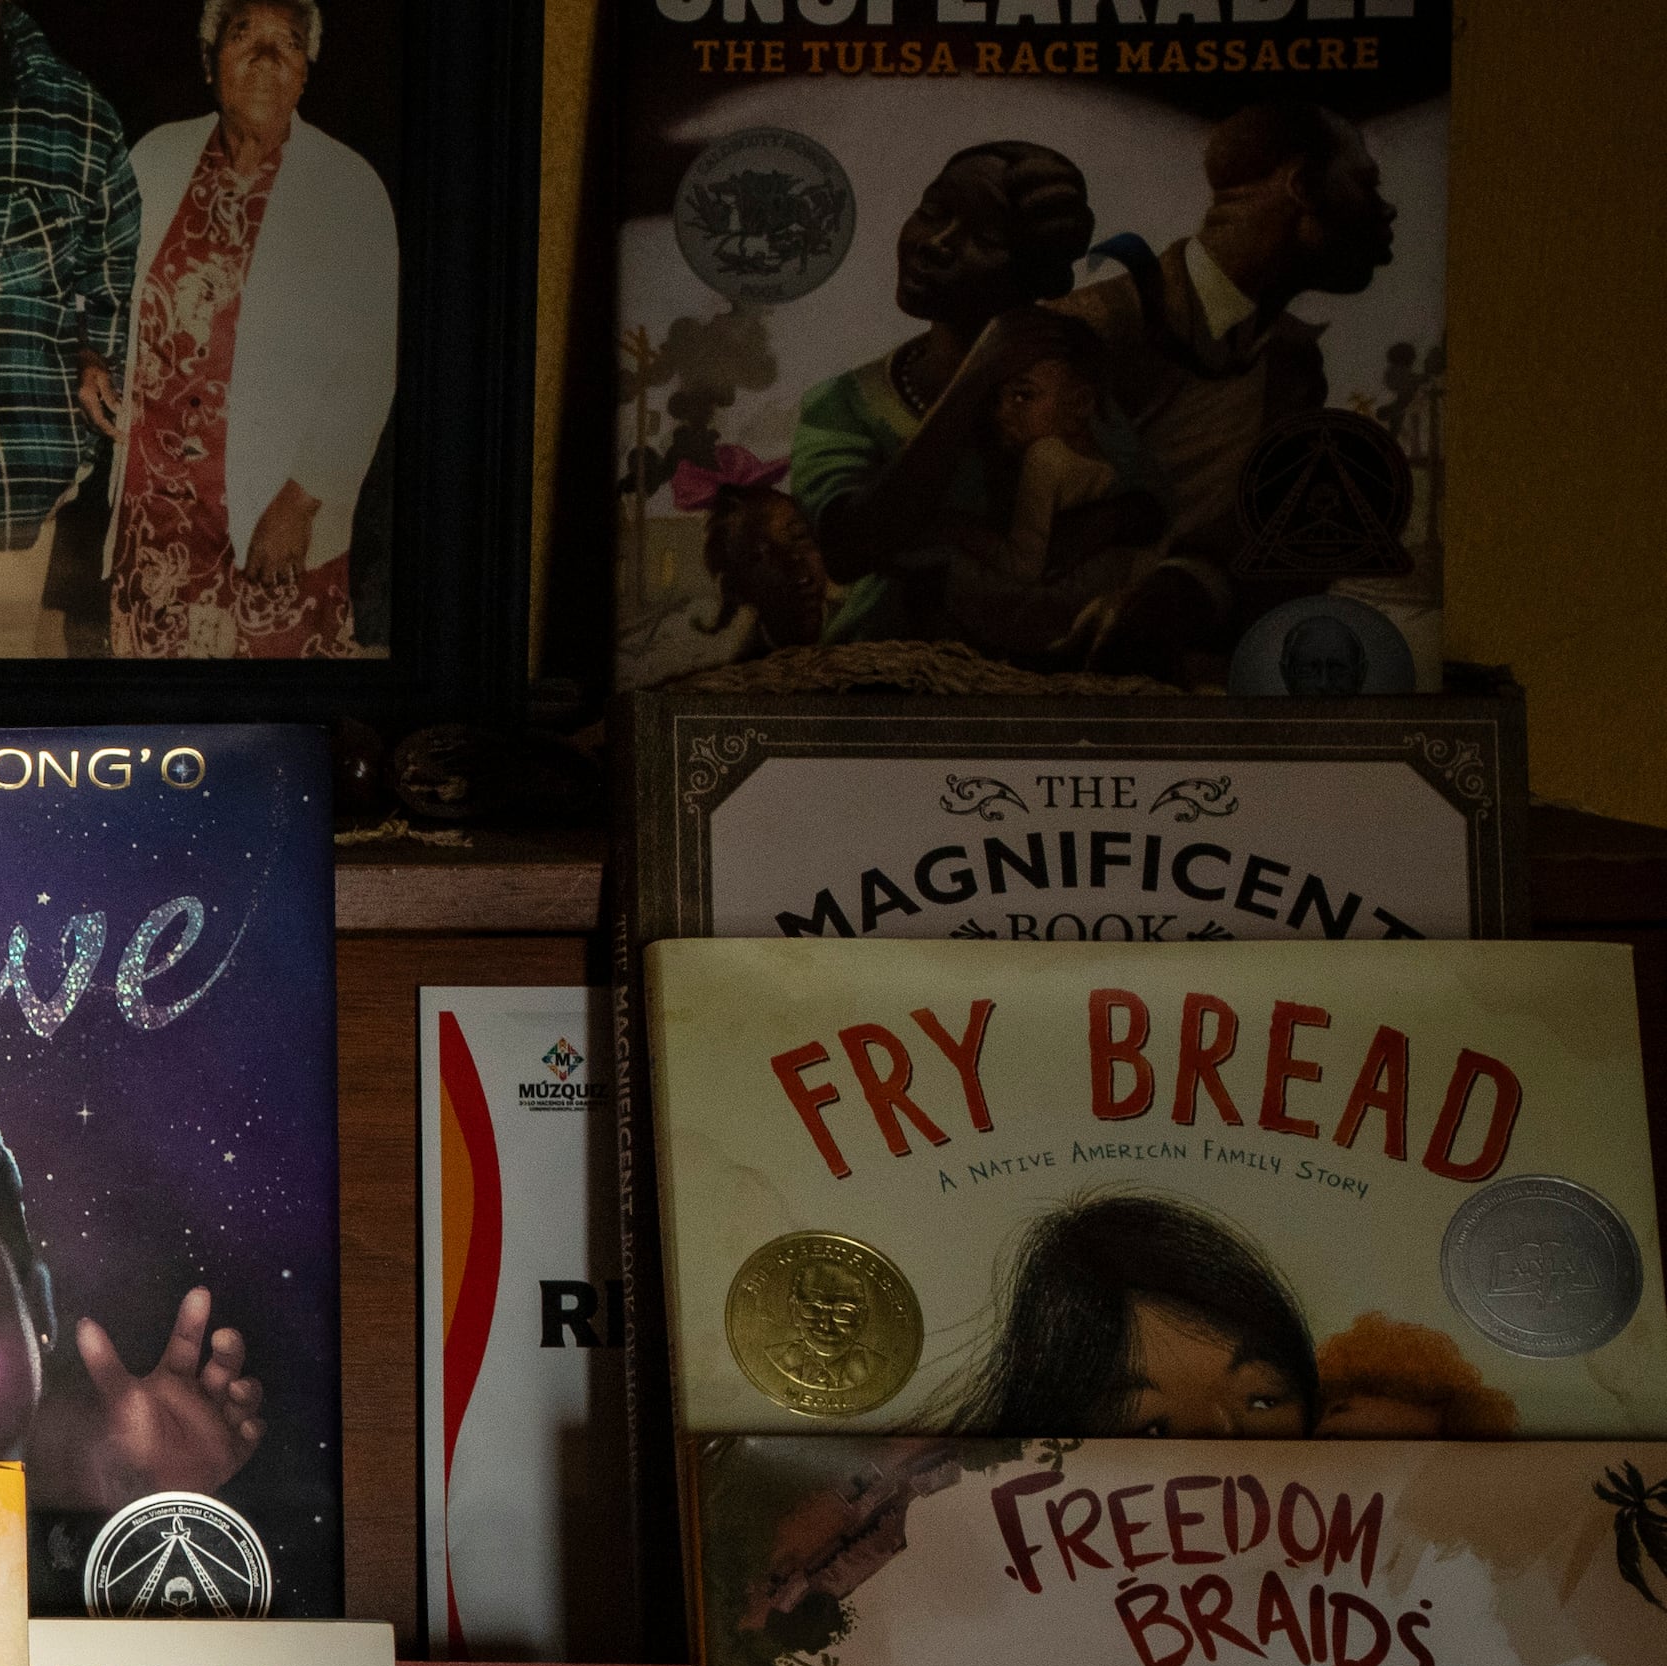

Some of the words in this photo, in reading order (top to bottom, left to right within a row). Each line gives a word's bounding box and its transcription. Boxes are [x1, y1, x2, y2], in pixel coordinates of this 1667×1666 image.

[693, 40, 787, 74] THE
[802, 41, 960, 76] TULSA
[975, 41, 1099, 75] RACE
[1115, 37, 1381, 73] MASSACRE
[1036, 776, 1138, 810] THE
[774, 831, 1425, 939] MAGNIFICENT
[771, 1000, 997, 1180] FRY
[1088, 988, 1523, 1183] BREAD
[939, 1169, 958, 1194] A
[991, 1470, 1384, 1593] FREEDOM
